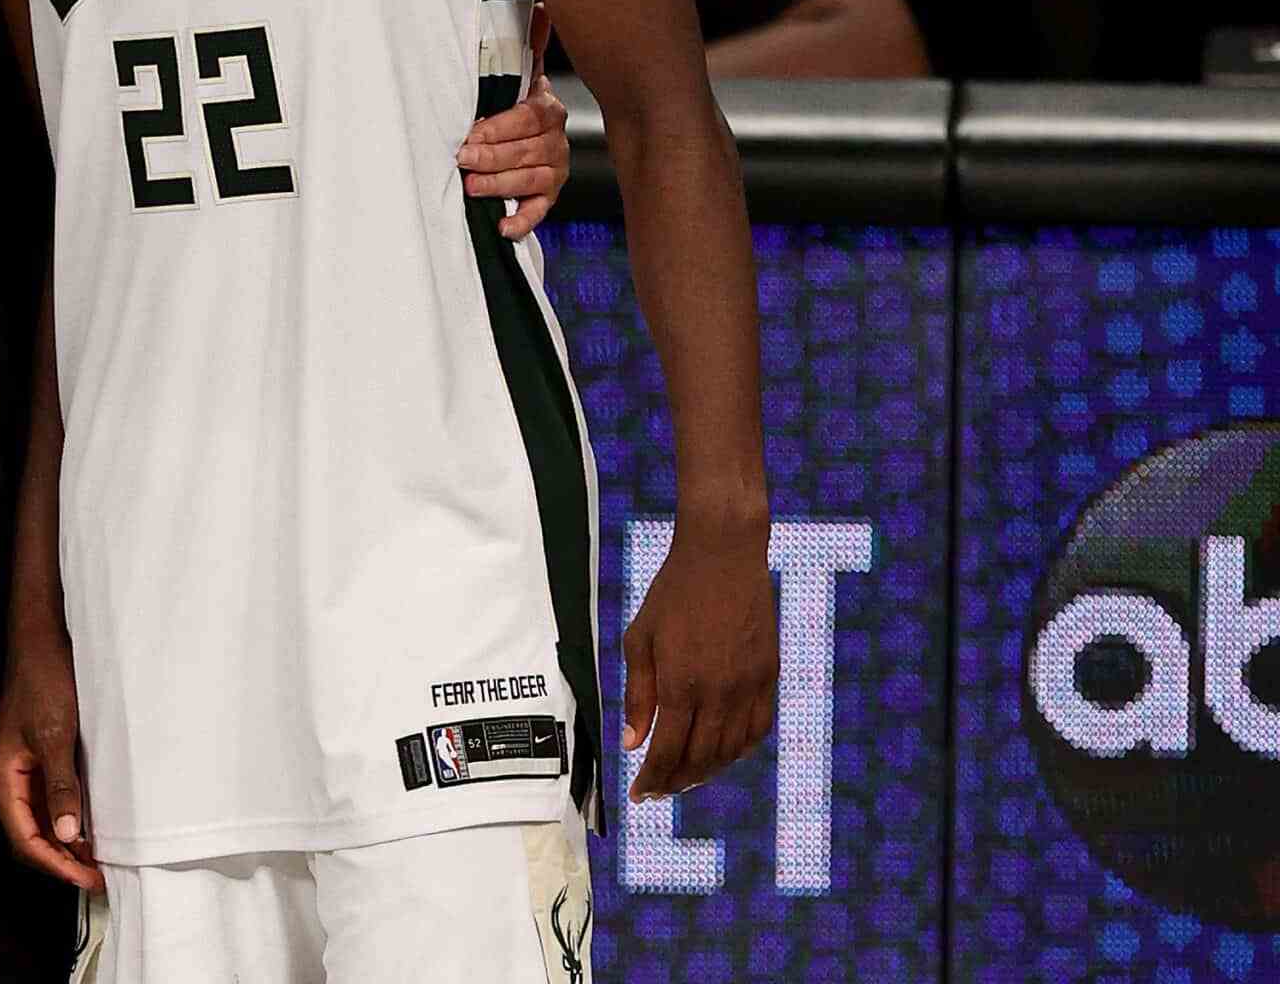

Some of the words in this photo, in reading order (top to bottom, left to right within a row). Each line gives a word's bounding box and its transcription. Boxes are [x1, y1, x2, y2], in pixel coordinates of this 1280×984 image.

[112, 23, 297, 211] 22
[431, 680, 475, 707] FEAR
[477, 677, 508, 702] THE
[509, 674, 548, 700] DEER
